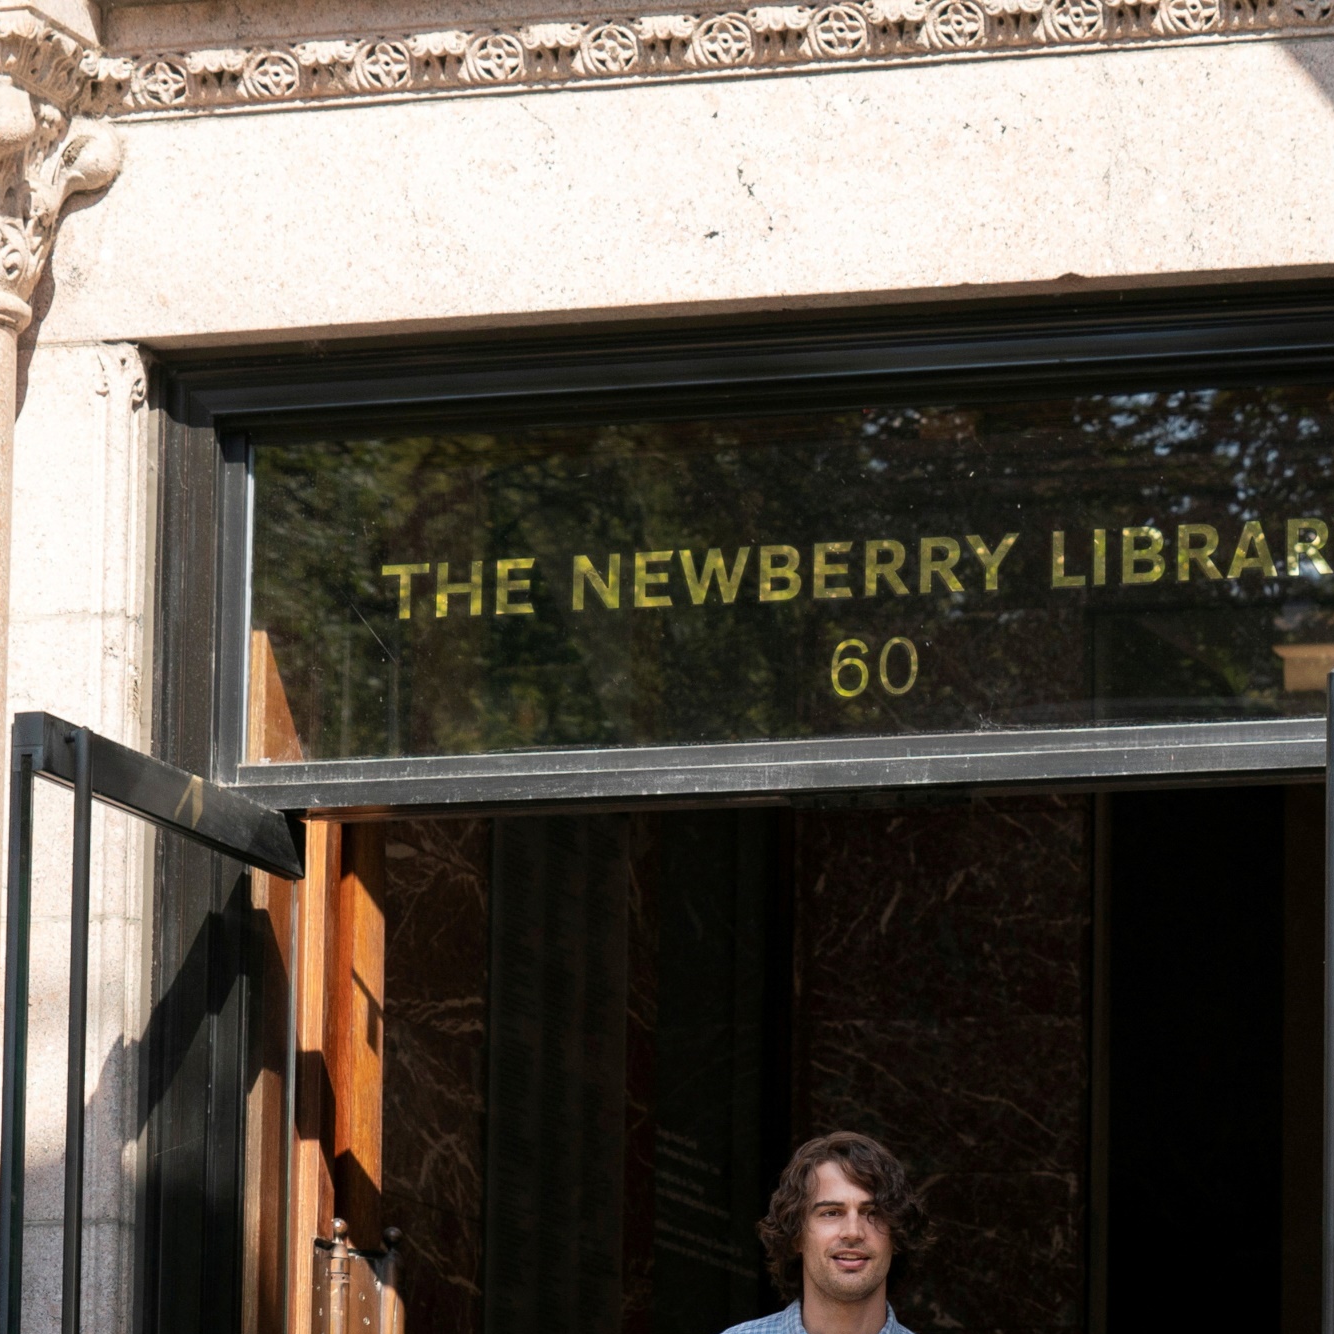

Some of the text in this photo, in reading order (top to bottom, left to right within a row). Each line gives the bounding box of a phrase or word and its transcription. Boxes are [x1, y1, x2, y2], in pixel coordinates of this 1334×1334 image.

[380, 557, 535, 620] THE
[572, 533, 1020, 611] NEWBERRY
[830, 636, 918, 698] 60
